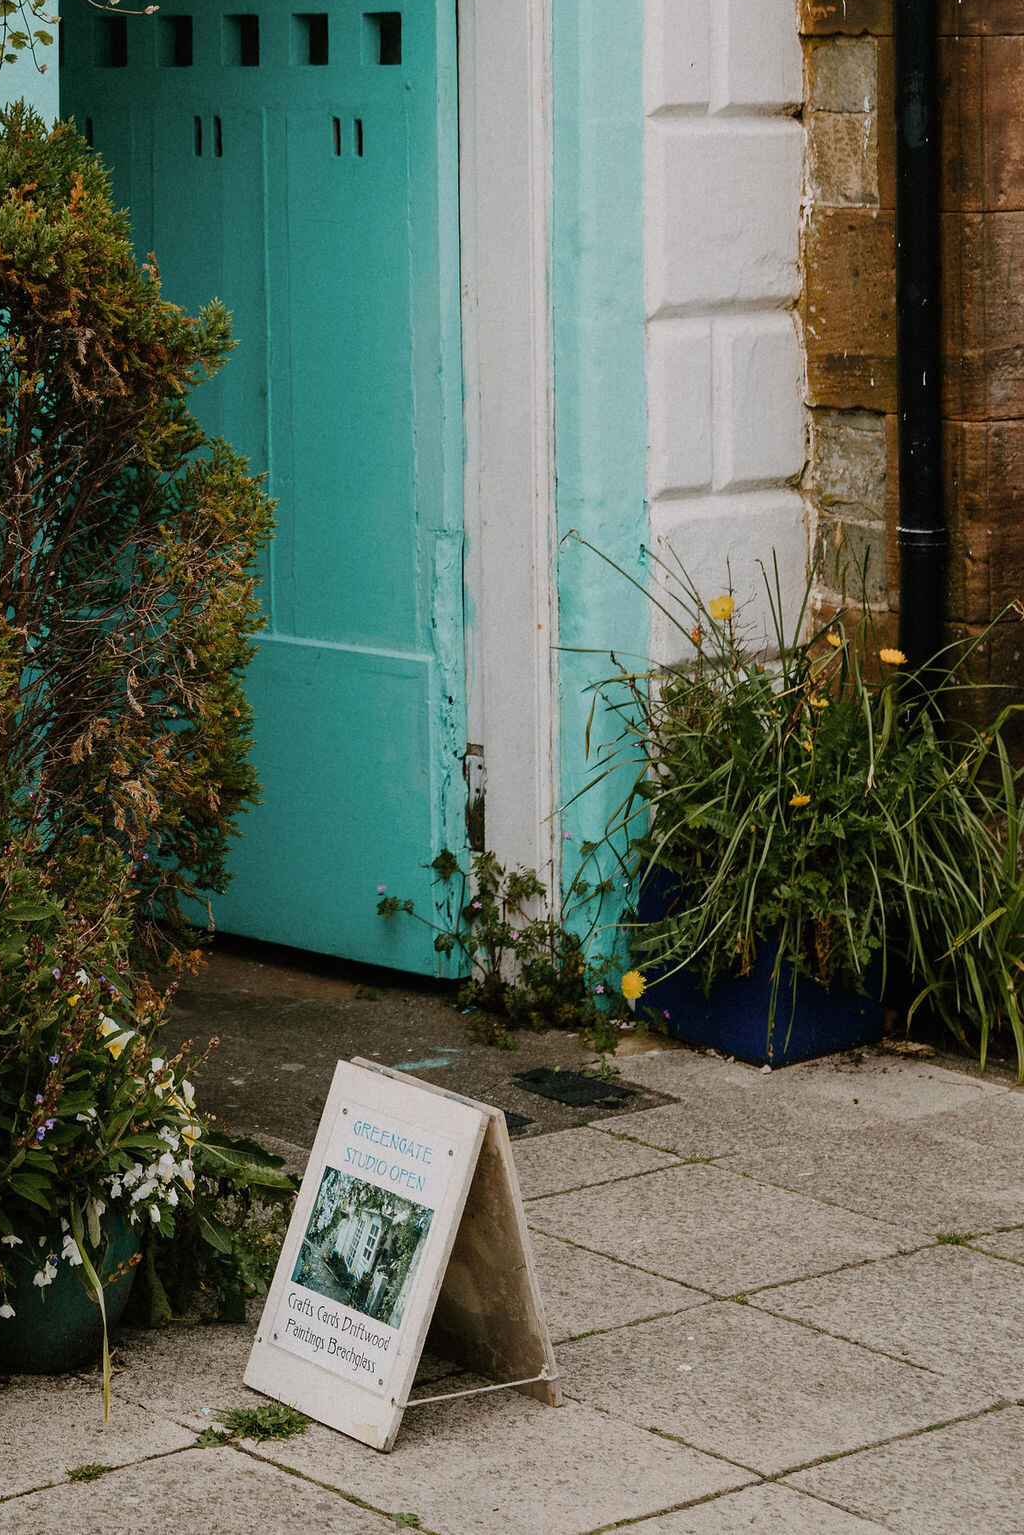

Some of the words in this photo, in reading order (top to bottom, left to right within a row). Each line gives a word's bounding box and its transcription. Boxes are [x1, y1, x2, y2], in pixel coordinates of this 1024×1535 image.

[353, 1120, 432, 1165] GREENGATE
[344, 1146, 388, 1176] STUDIO
[389, 1165, 426, 1193] OPEN
[285, 1318, 325, 1353] Paintings
[327, 1336, 376, 1373] Beachglass
[288, 1292, 314, 1317] Crafts
[317, 1305, 340, 1329] Cards
[341, 1316, 391, 1351] Driftwood
